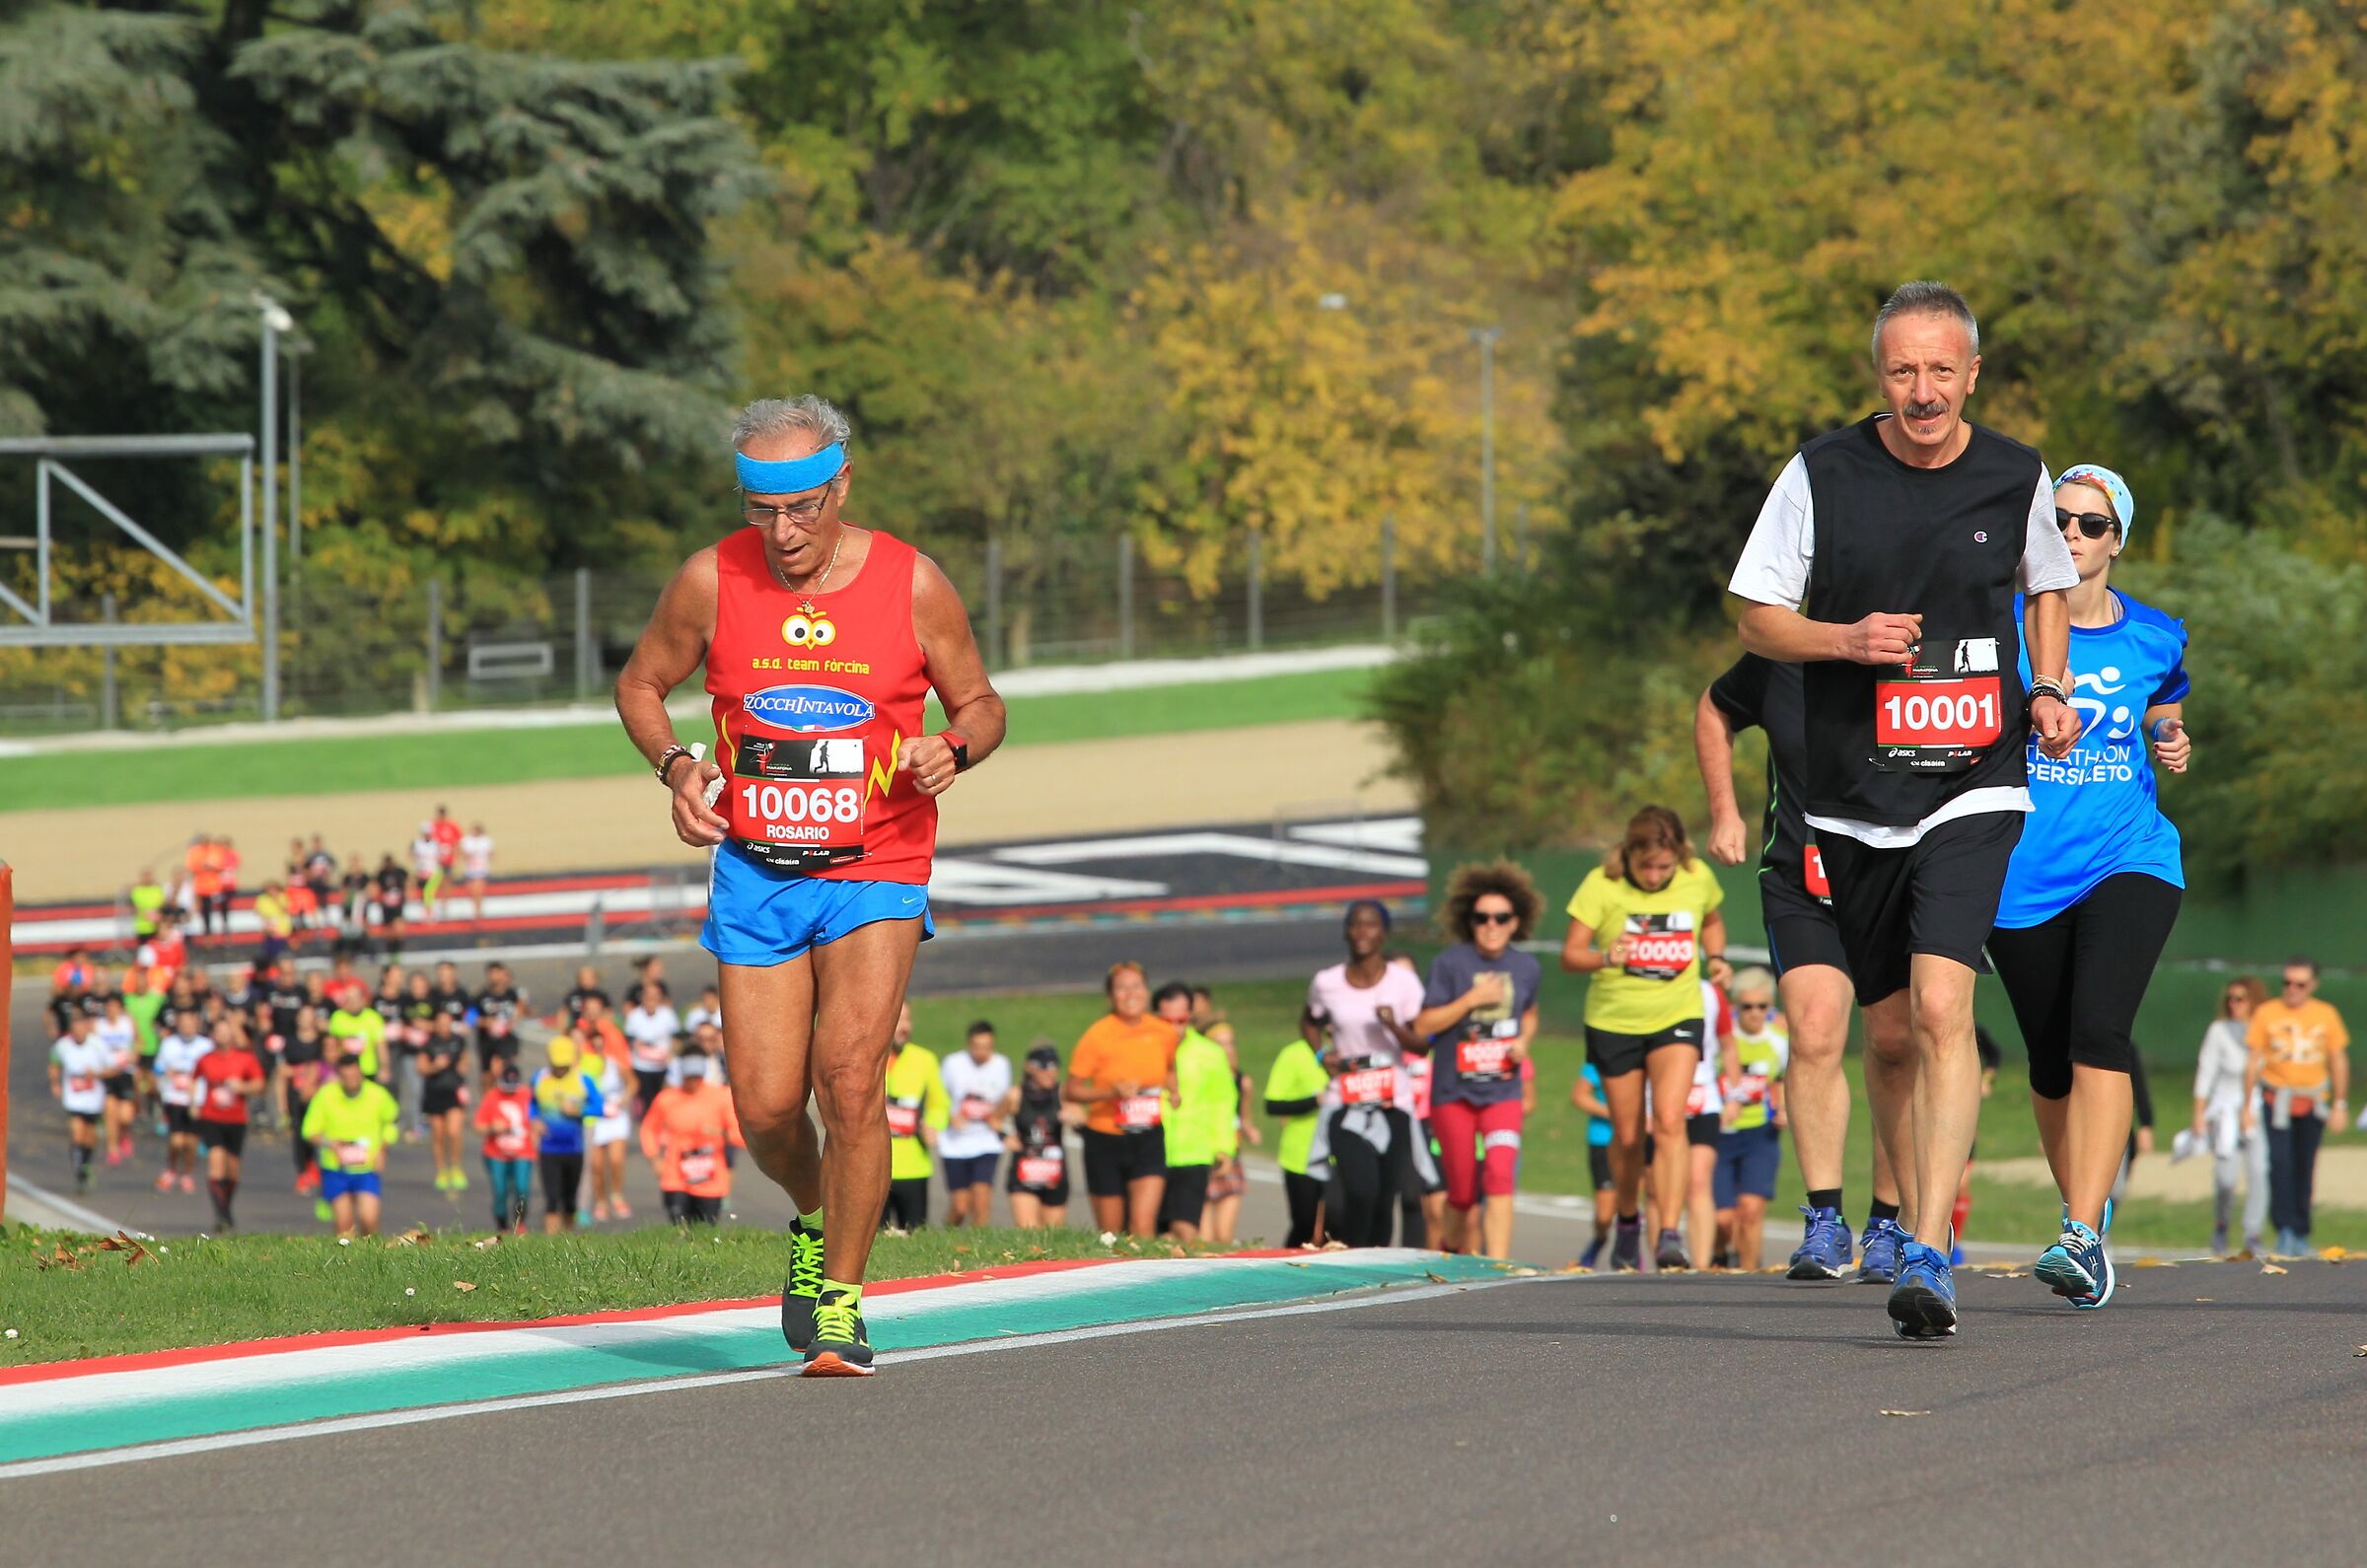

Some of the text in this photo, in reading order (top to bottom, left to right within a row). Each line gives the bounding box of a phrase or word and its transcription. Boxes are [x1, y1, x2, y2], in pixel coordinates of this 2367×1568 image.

[752, 658, 782, 670] a.s.d.
[787, 659, 820, 672] team
[746, 695, 874, 717] ZOCCHINTAVOLA
[1885, 693, 1994, 730] 10001
[742, 784, 859, 822] 10068
[766, 824, 829, 840] ROSARIO
